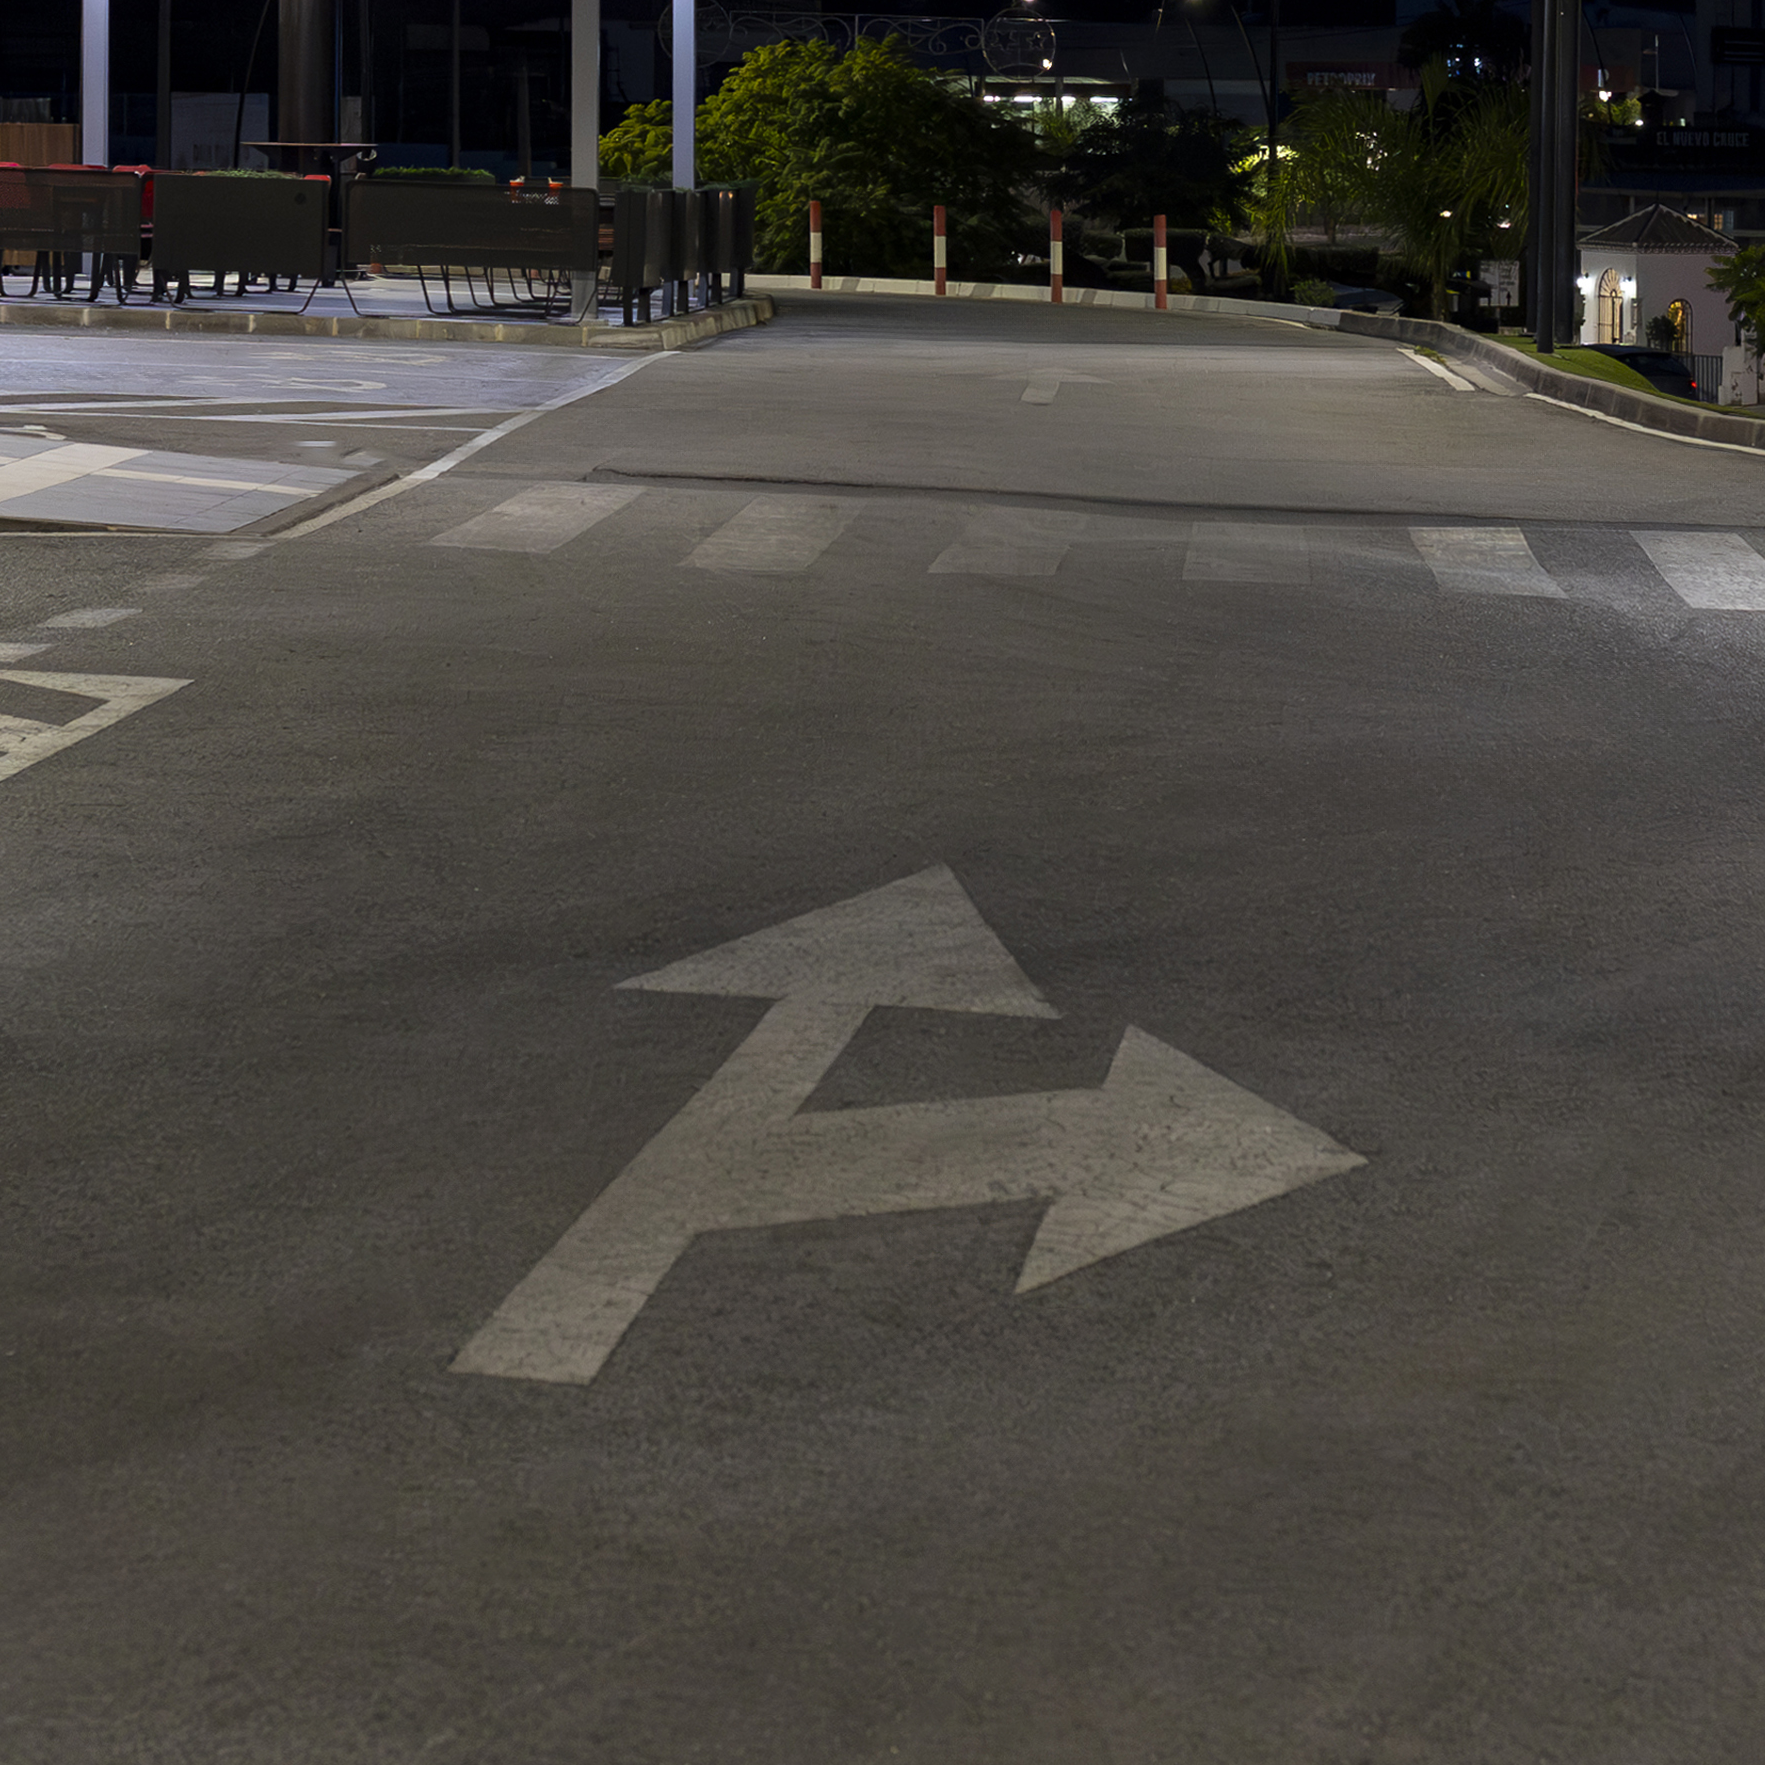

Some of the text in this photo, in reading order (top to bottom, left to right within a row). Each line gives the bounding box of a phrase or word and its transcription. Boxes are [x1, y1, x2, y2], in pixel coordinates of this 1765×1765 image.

[1656, 131, 1750, 147] EL NUEVO CRUCE
